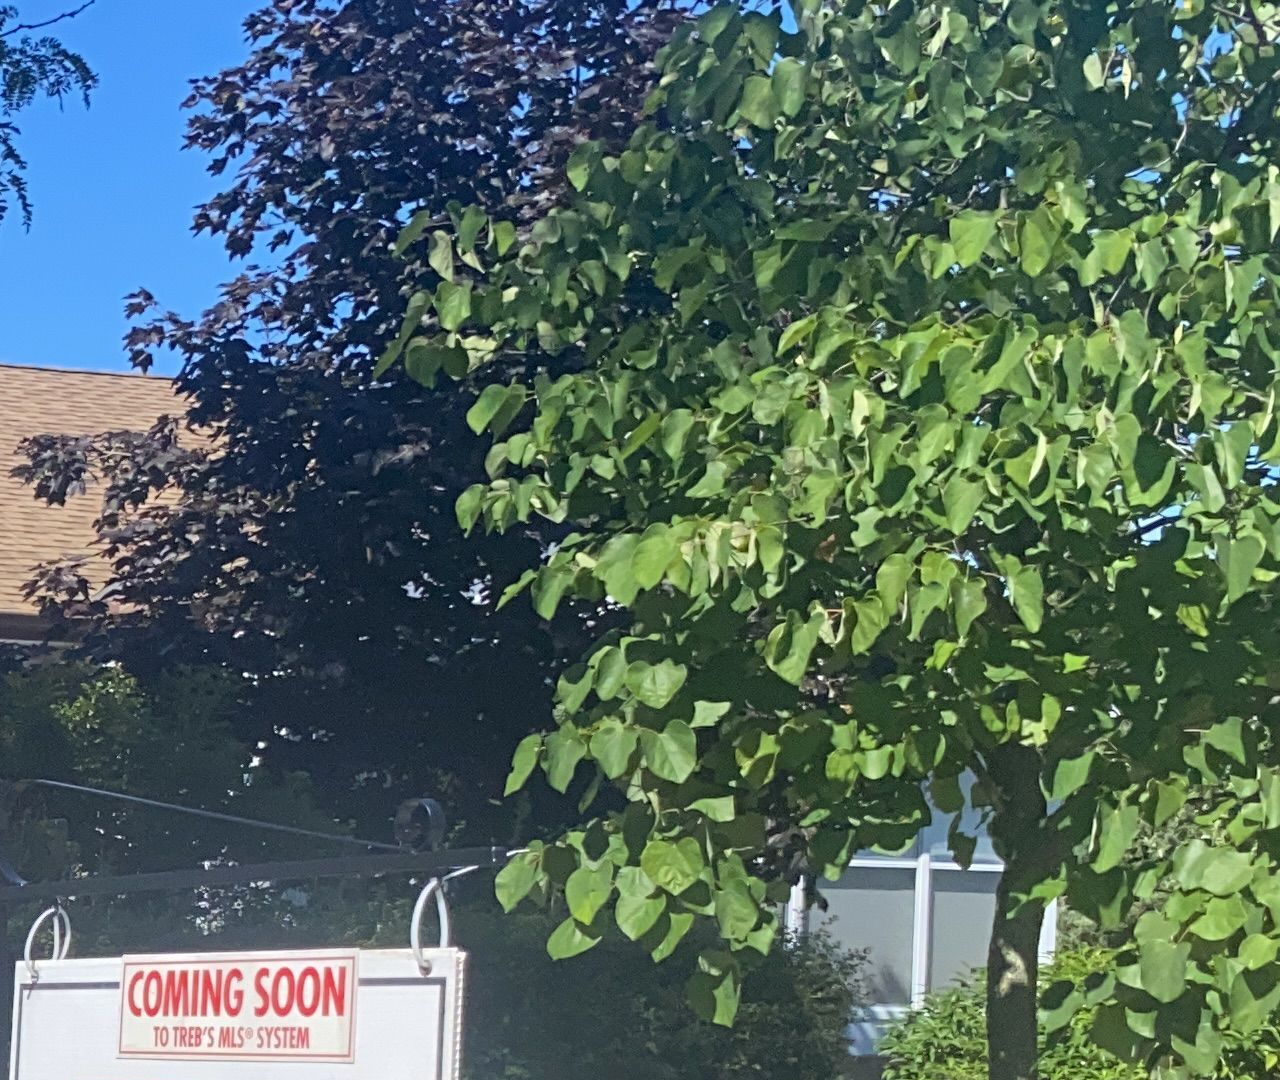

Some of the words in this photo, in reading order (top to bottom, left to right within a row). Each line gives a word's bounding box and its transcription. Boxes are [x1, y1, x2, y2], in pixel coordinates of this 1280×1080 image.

[127, 968, 244, 1018] COMING
[253, 966, 347, 1018] SOON
[153, 1026, 169, 1047] TO
[172, 1026, 215, 1048] TREB'S
[256, 1026, 310, 1049] SYSTEM
